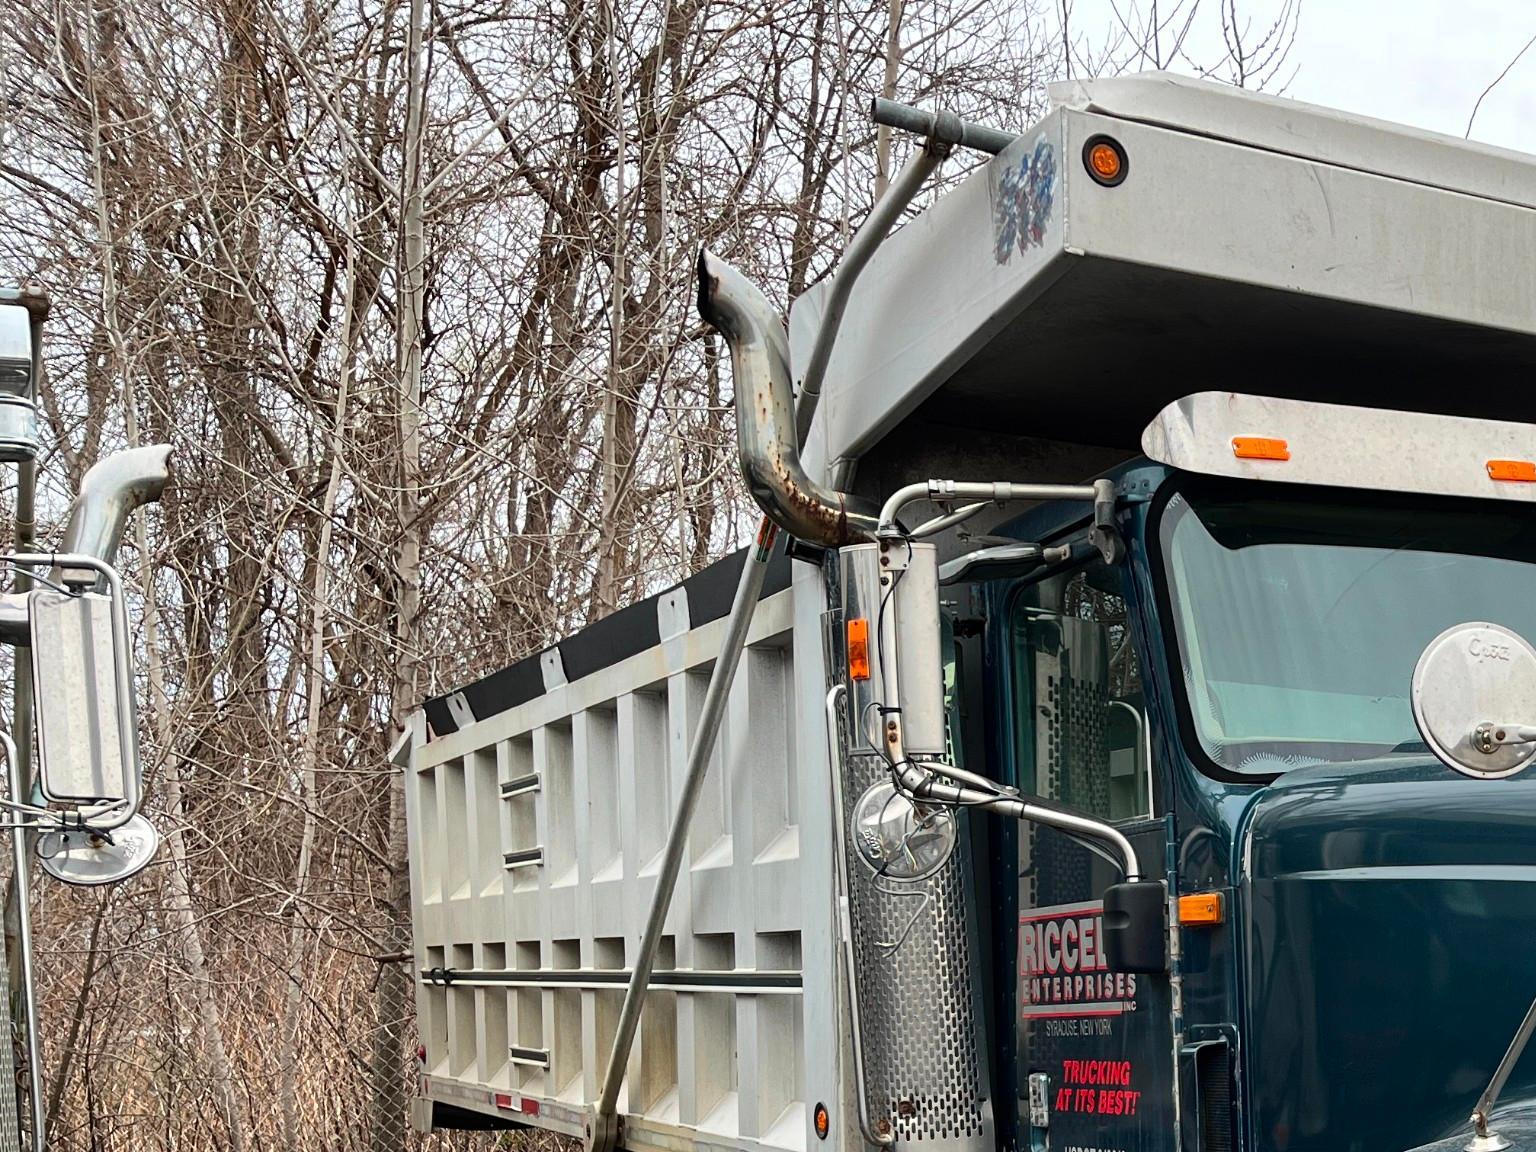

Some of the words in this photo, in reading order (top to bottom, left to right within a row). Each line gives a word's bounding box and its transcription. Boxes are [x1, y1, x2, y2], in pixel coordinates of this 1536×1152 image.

[1019, 916, 1109, 976] RICCEL
[1022, 973, 1137, 1004] ENTERPRISES
[1122, 1000, 1137, 1012] INC
[1080, 1019, 1093, 1036] NEW
[1094, 1018, 1112, 1036] YORK
[1063, 1060, 1131, 1086] TRUCKING
[1055, 1088, 1072, 1111] AT
[1074, 1088, 1095, 1113] ITS
